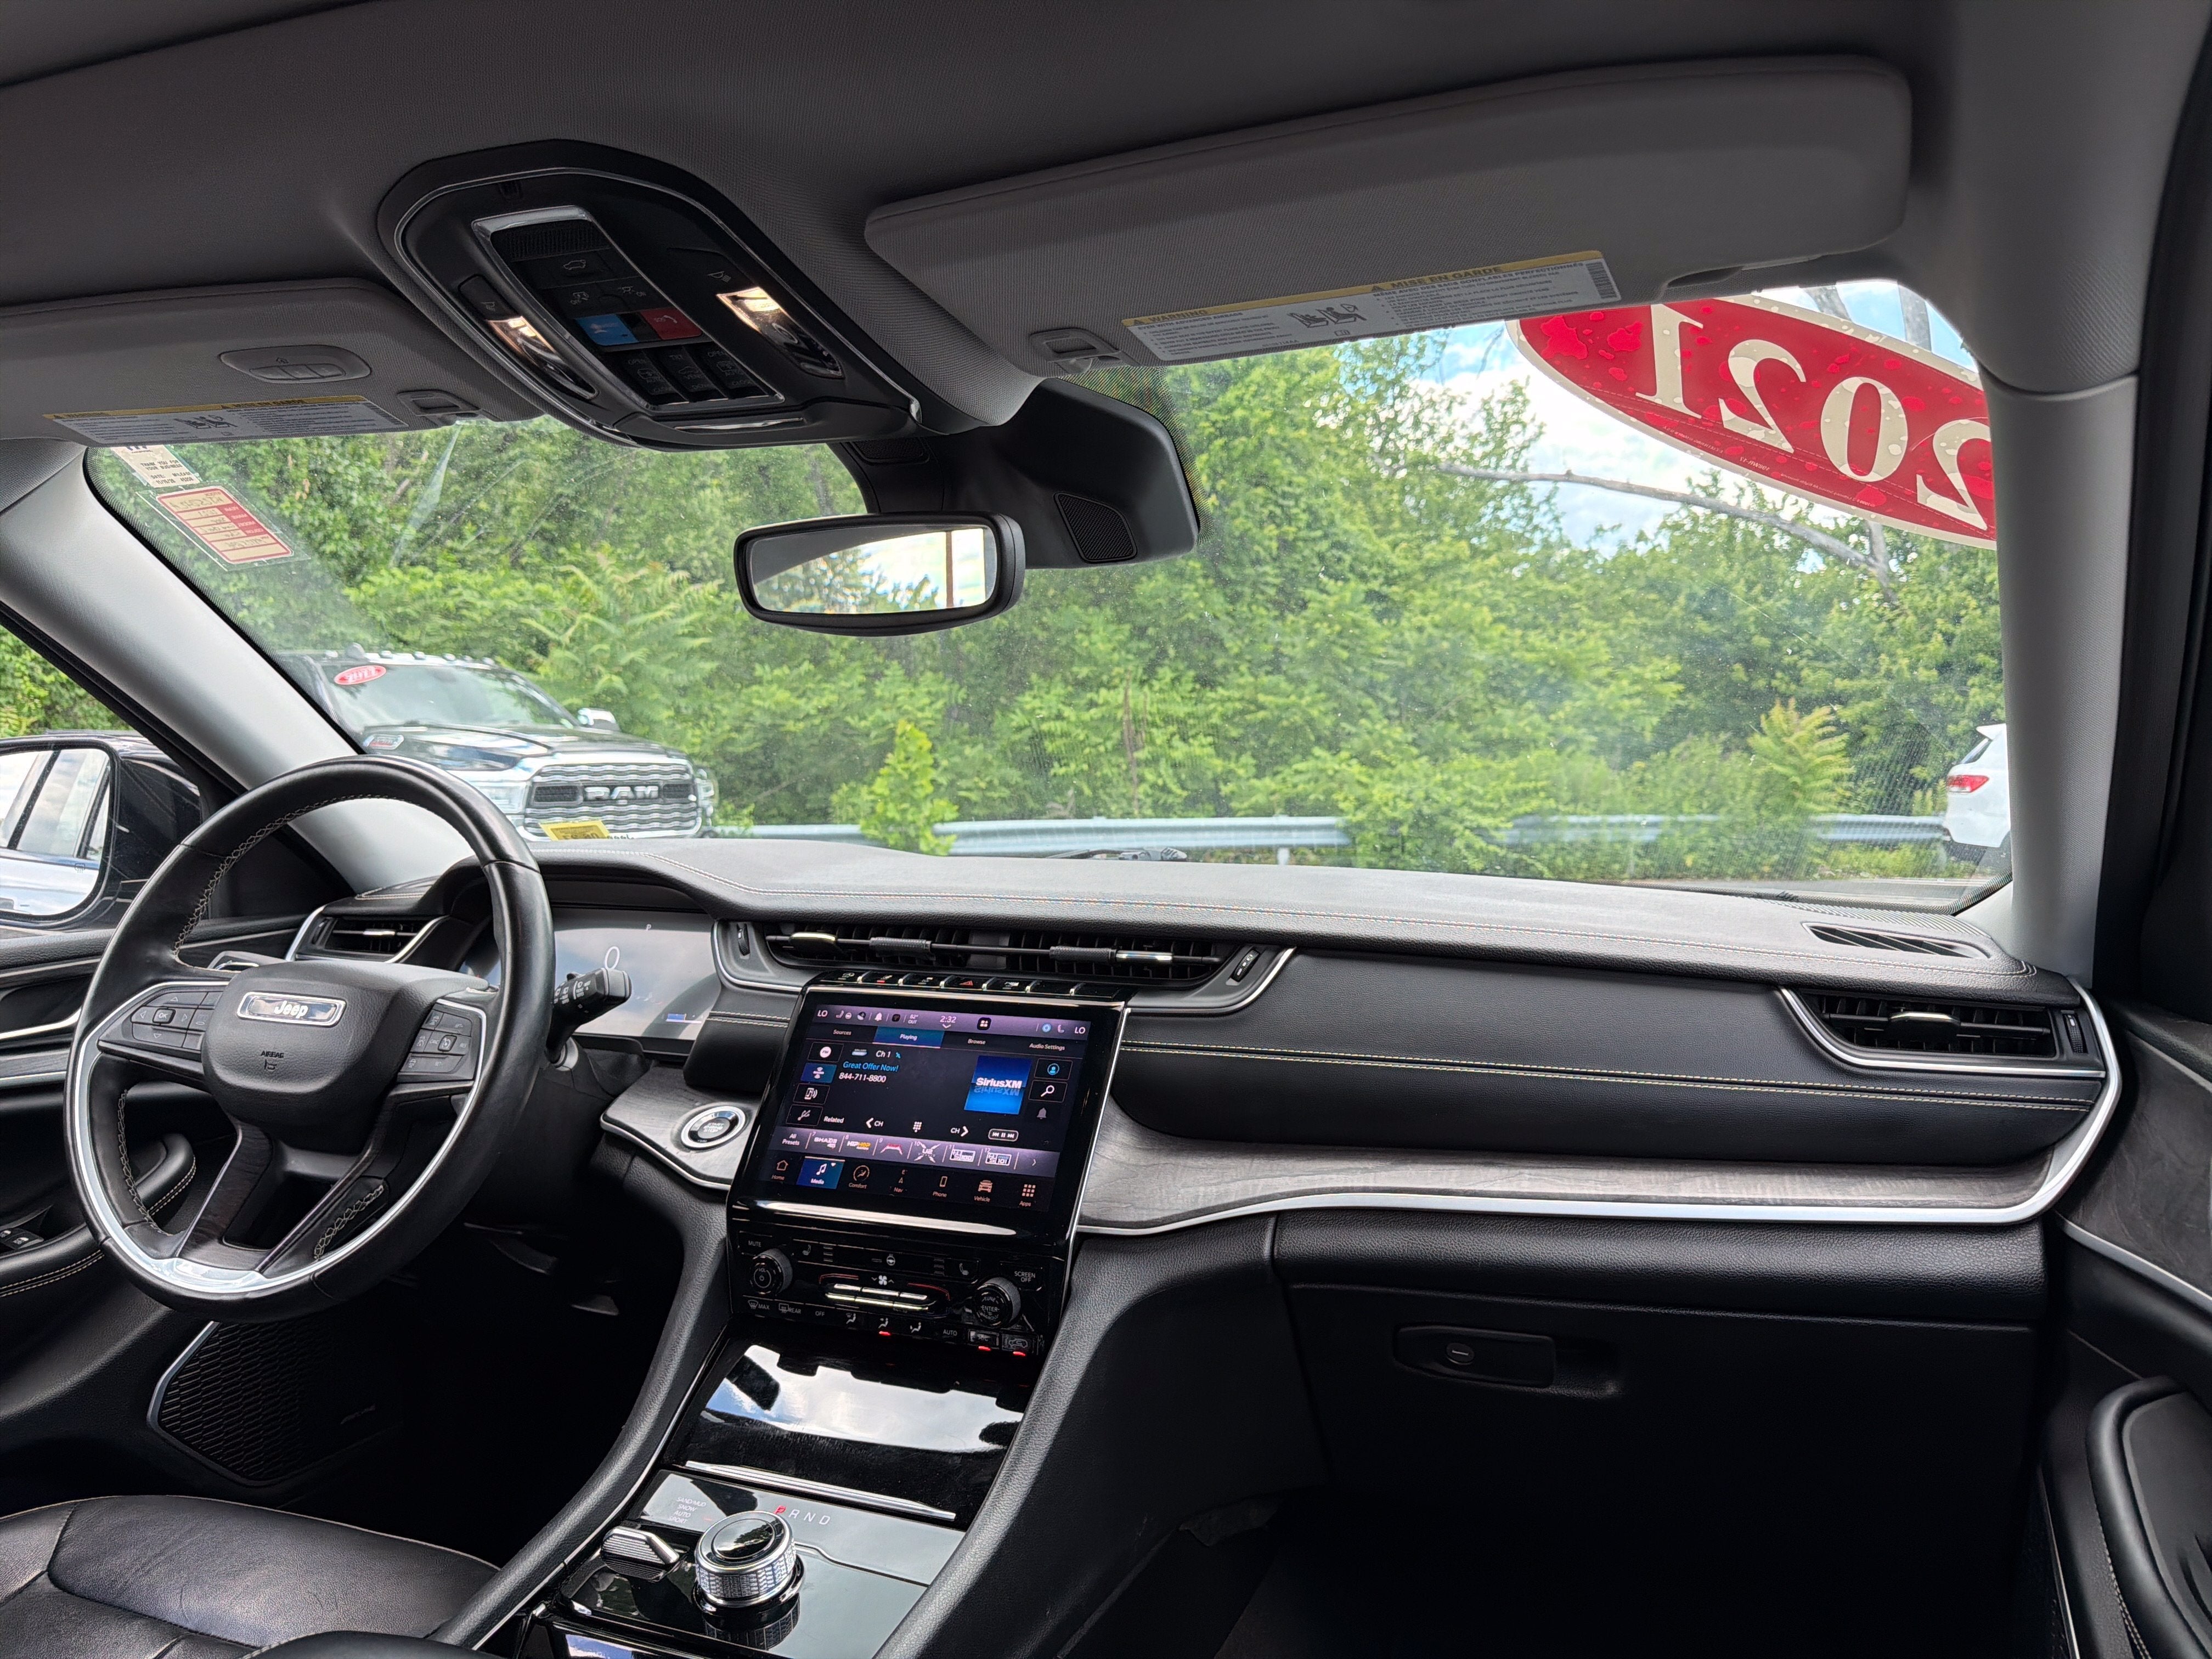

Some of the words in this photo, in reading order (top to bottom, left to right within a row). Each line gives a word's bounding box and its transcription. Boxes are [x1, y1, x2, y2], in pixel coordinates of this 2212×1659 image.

[1391, 278, 1423, 288] MISE
[1452, 267, 1502, 279] GARDE
[1148, 309, 1207, 321] WARNING
[584, 786, 659, 800] RAM
[274, 1000, 308, 1018] Jeep
[940, 1015, 957, 1024] 2:32
[261, 1051, 285, 1059] AIRBAG
[862, 1062, 879, 1070] Offer
[879, 1063, 899, 1072] Now!
[839, 1072, 887, 1083] 844-711-8800
[975, 1077, 1023, 1089] SiriusXM
[676, 1496, 707, 1507] SAND/MUD
[774, 1505, 786, 1514] P
[788, 1509, 800, 1519] R
[803, 1512, 816, 1522] N
[819, 1515, 831, 1525] D
